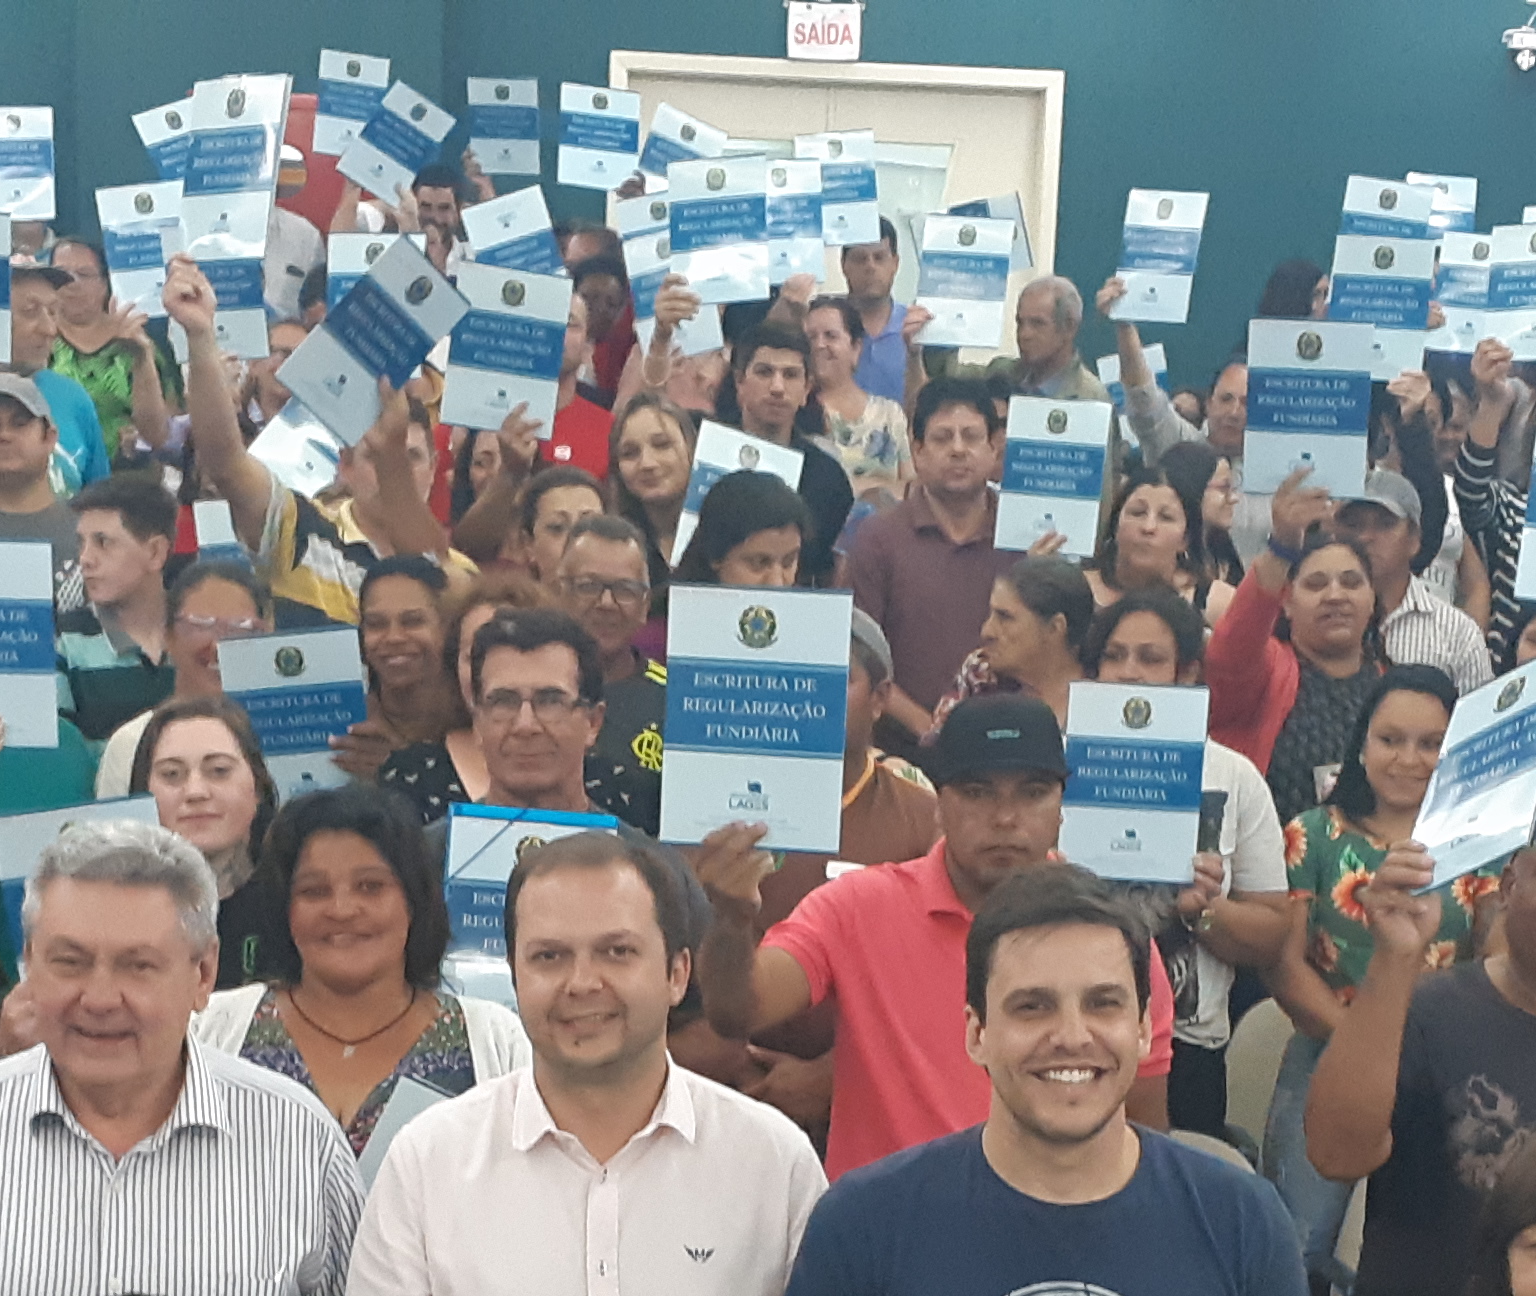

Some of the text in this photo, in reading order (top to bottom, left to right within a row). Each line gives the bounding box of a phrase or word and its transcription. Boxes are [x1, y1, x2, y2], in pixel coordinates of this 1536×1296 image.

[794, 15, 853, 45] SAÍDA
[9, 609, 29, 622] DE
[693, 670, 817, 693] ESCRITURA DE
[682, 695, 825, 720] REGULARIZAÇÃO
[254, 708, 351, 729] GULARIZAÇÃO
[704, 722, 799, 743] FUNDIÁRIA
[1085, 746, 1181, 763] ESCRITURA DE
[1077, 765, 1187, 784] REGULARIZAÇÃO
[1094, 785, 1167, 801] FUNDIÁRIA
